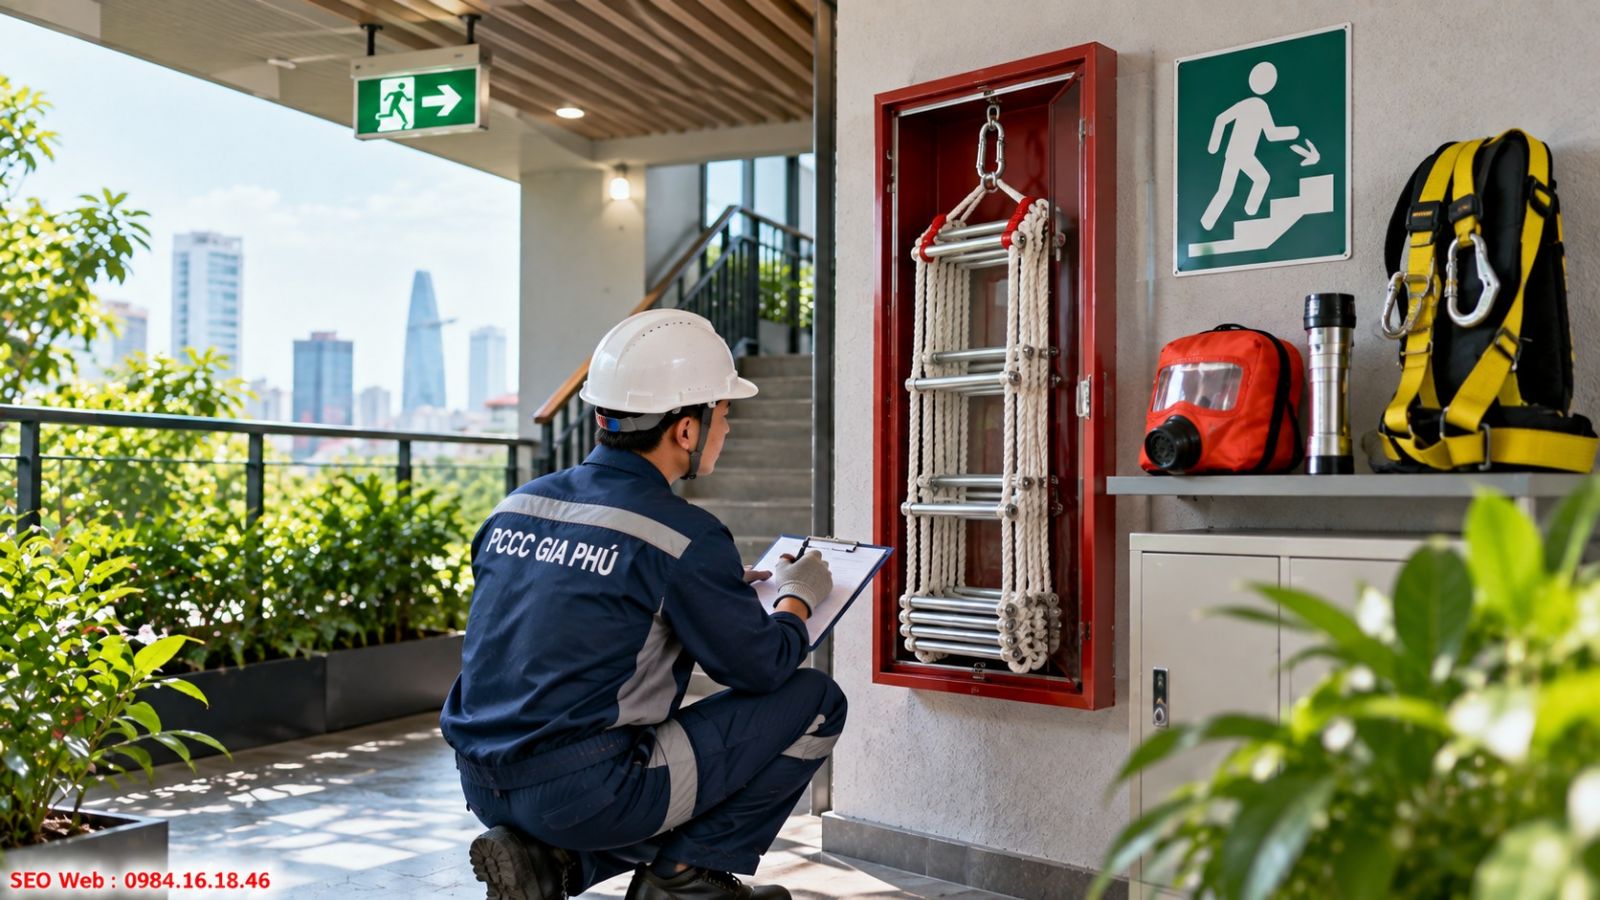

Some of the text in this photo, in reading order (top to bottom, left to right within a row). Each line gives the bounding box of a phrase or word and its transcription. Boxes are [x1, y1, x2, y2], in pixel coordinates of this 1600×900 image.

[486, 528, 619, 576] PCCC GIA PHÚ
